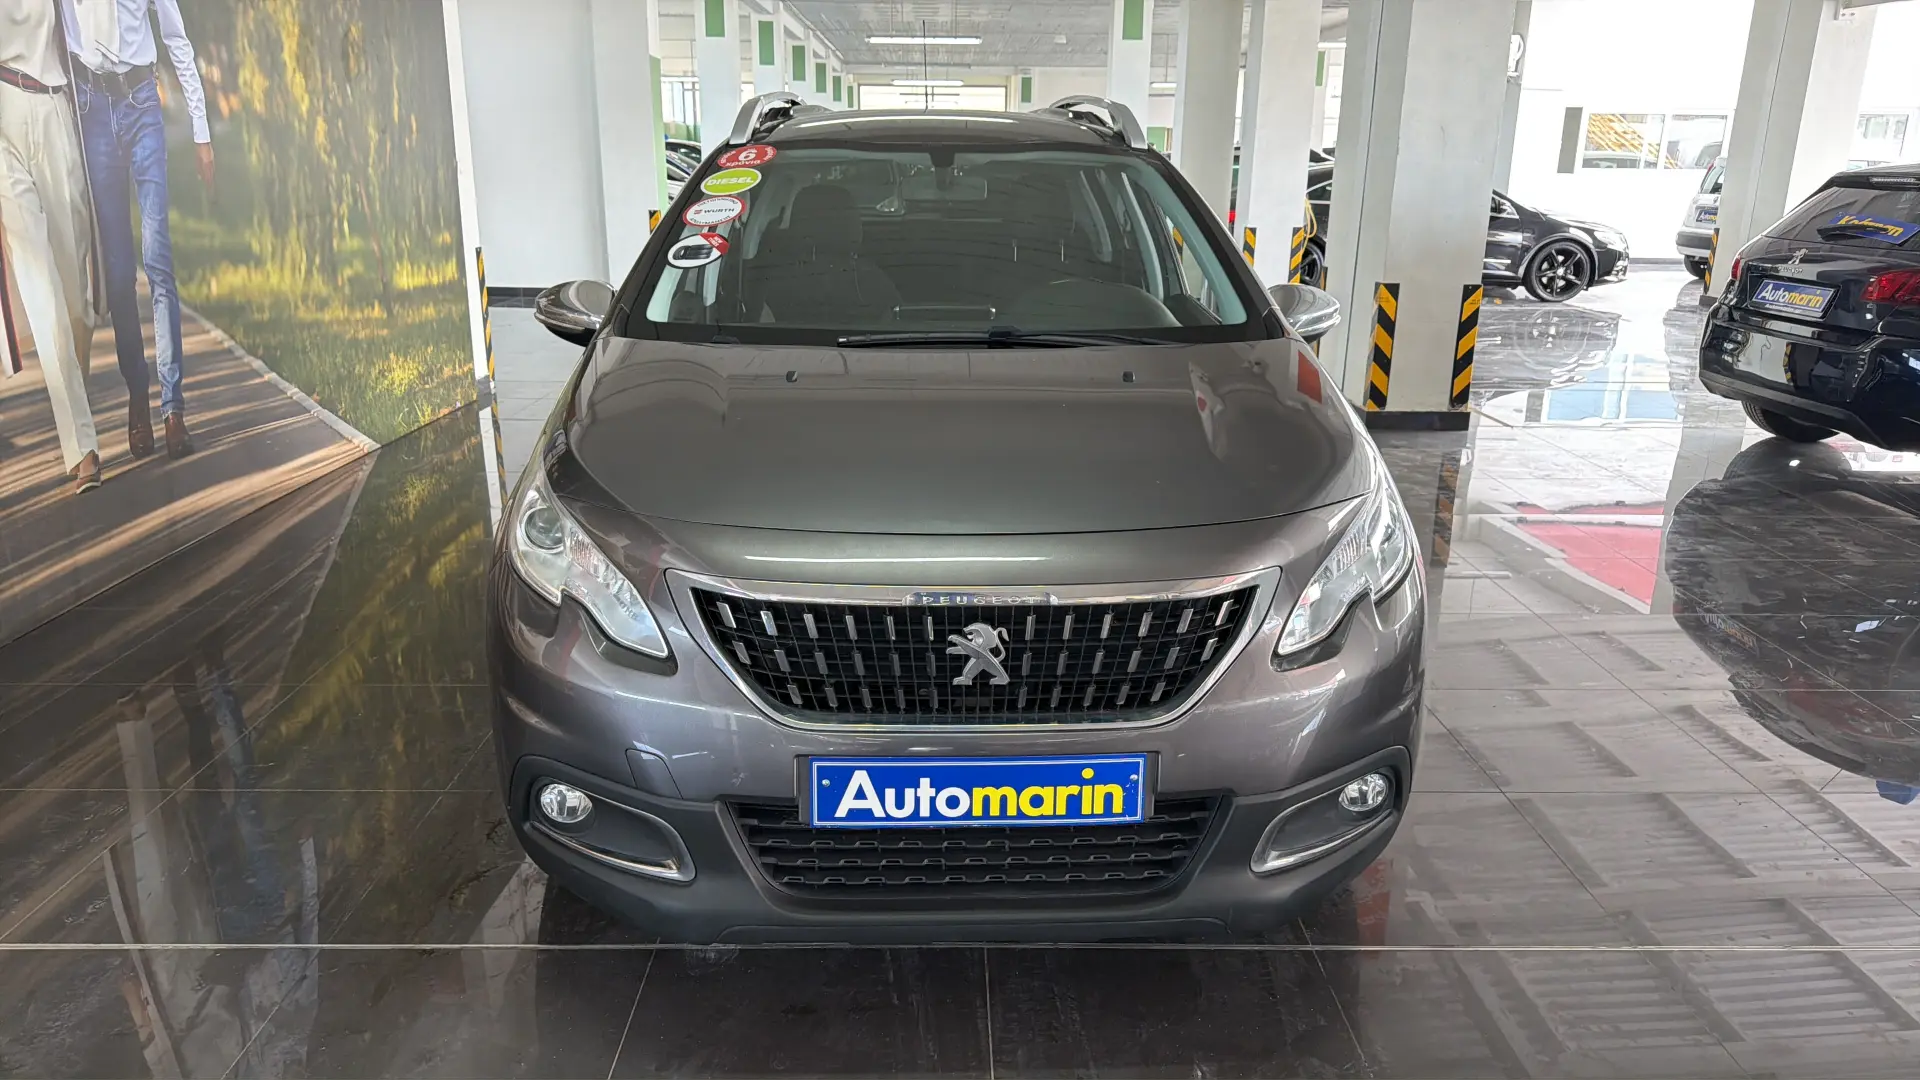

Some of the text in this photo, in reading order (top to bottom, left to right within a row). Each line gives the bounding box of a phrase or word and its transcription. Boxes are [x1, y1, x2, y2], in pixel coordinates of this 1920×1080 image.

[738, 149, 757, 161] 6
[707, 177, 754, 186] DIESEL
[1758, 283, 1823, 308] Automarin
[922, 595, 1041, 605] PEUGEOT
[834, 768, 1123, 818] Automarin
